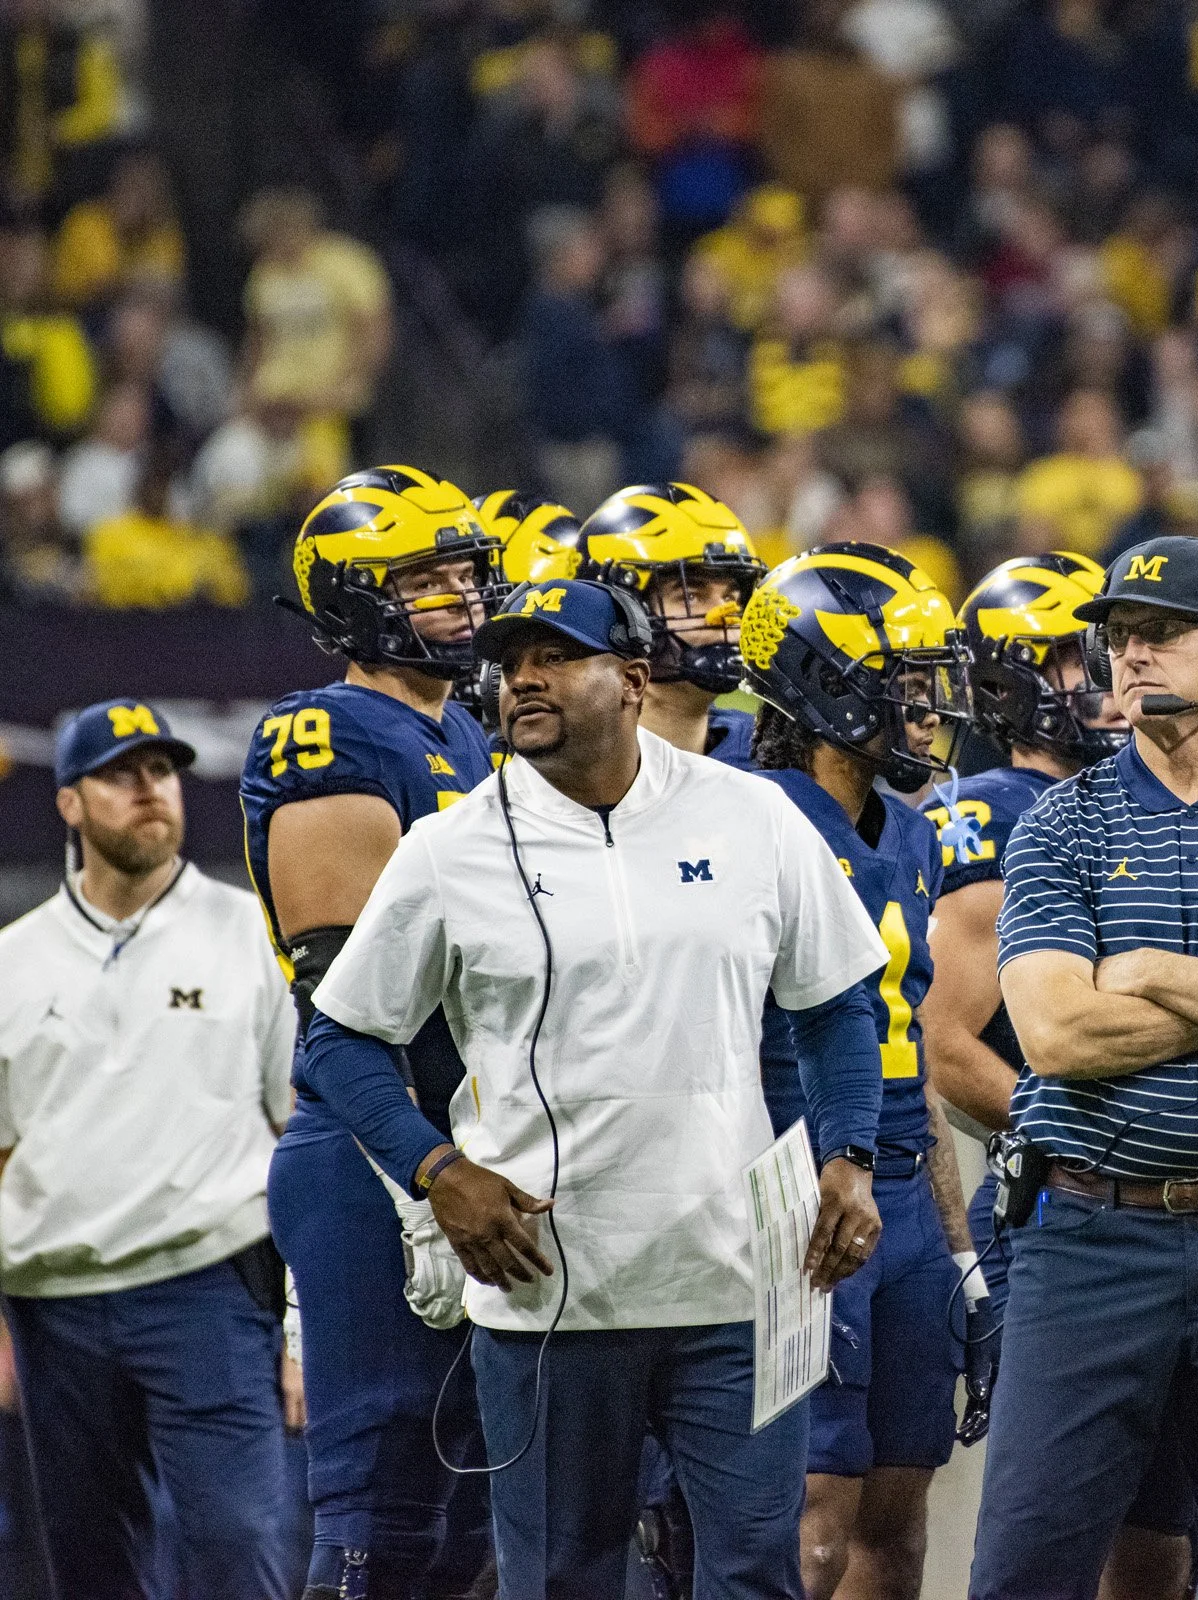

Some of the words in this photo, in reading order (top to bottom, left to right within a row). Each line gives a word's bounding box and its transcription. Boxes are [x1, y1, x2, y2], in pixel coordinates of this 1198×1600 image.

[1124, 555, 1169, 582] M
[521, 588, 567, 612] M
[106, 704, 160, 738] M
[262, 707, 335, 778] 79
[677, 859, 714, 883] M
[169, 987, 203, 1009] M
